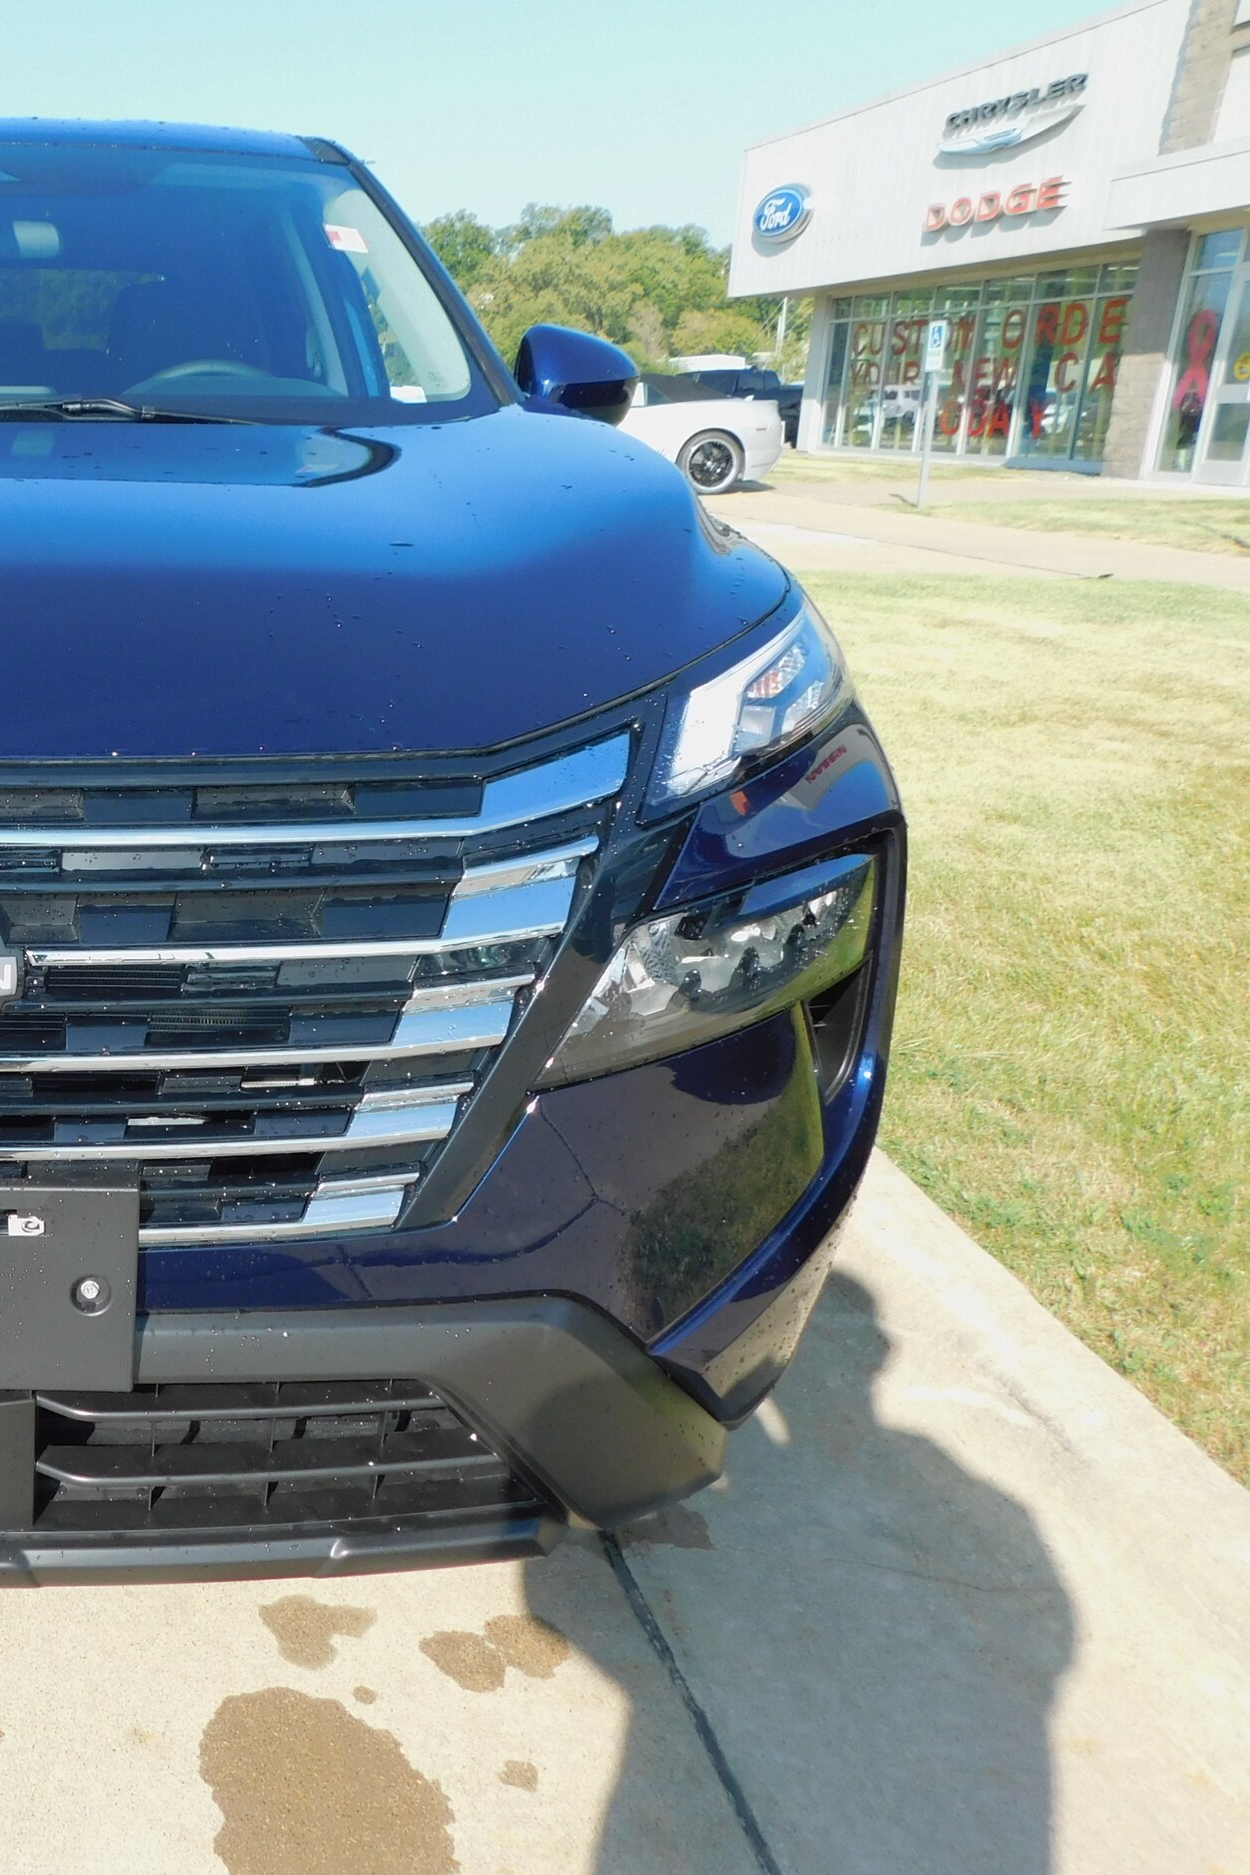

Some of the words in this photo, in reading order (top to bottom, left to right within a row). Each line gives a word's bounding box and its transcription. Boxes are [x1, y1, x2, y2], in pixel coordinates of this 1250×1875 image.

[947, 73, 1088, 129] CHRYSLER
[760, 197, 793, 231] Ford
[925, 175, 1072, 232] DODGE
